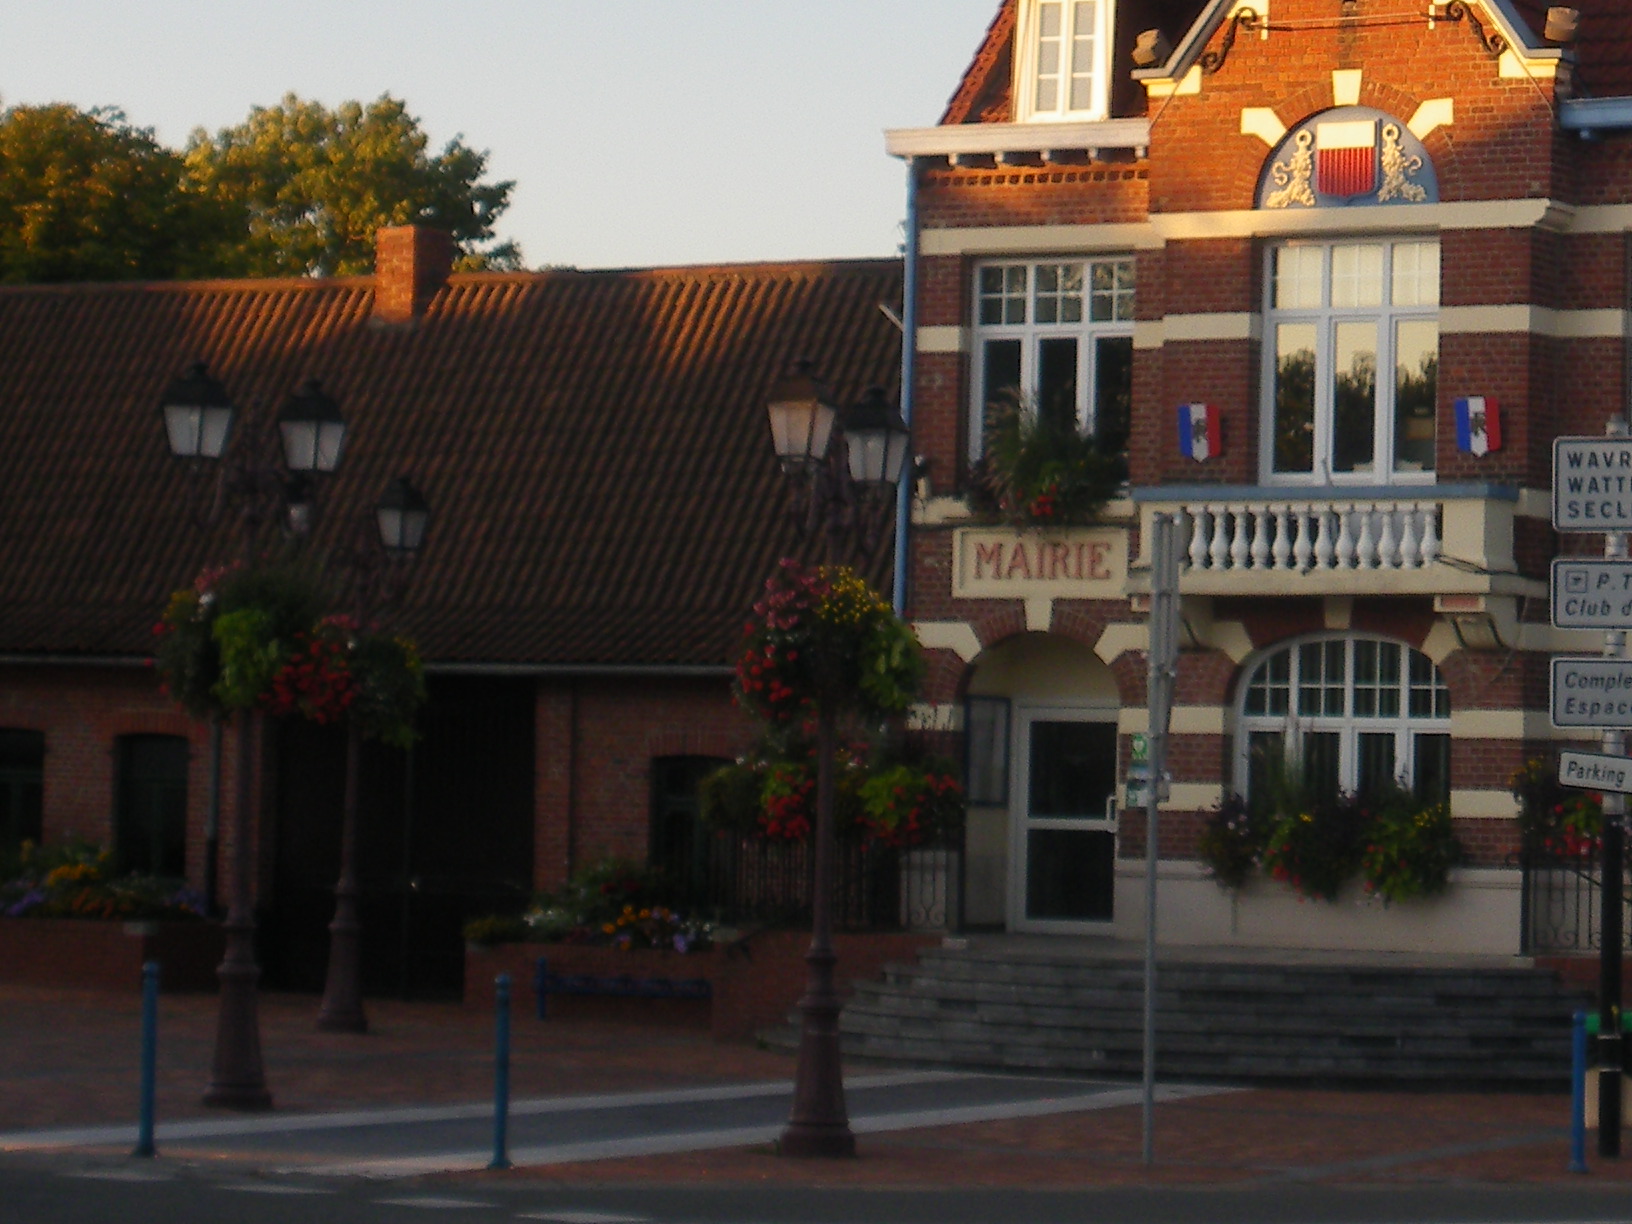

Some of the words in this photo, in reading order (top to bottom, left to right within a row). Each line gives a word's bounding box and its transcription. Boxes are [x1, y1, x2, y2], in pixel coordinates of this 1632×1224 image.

[974, 542, 1112, 580] MAIRIE
[1564, 598, 1612, 617] Club
[1566, 760, 1627, 788] Parking
